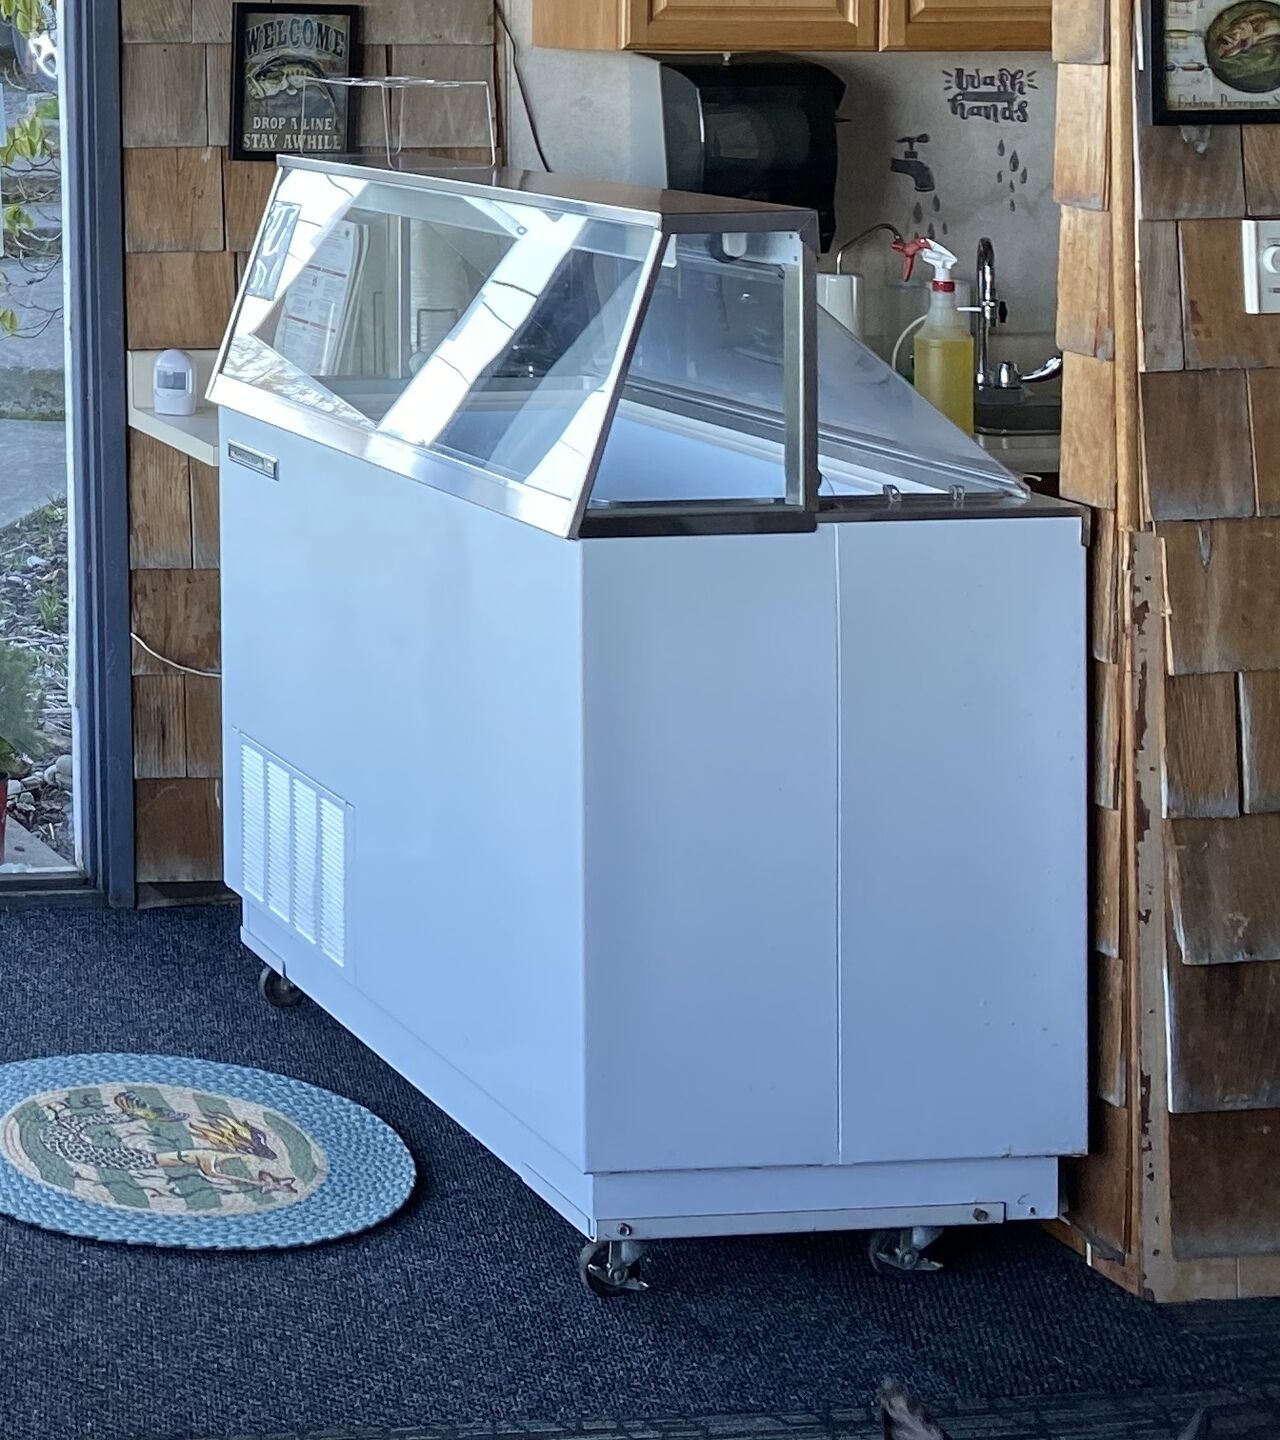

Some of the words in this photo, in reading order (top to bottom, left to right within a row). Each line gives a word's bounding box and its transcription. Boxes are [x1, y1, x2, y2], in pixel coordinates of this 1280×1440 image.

[246, 18, 346, 59] WELCOME
[954, 68, 1026, 95] Wash
[947, 92, 1028, 123] hands
[253, 116, 286, 130] DROP
[290, 117, 298, 130] A
[302, 118, 333, 130] LINE
[243, 133, 278, 149] STAY
[283, 134, 342, 150] AWHILE
